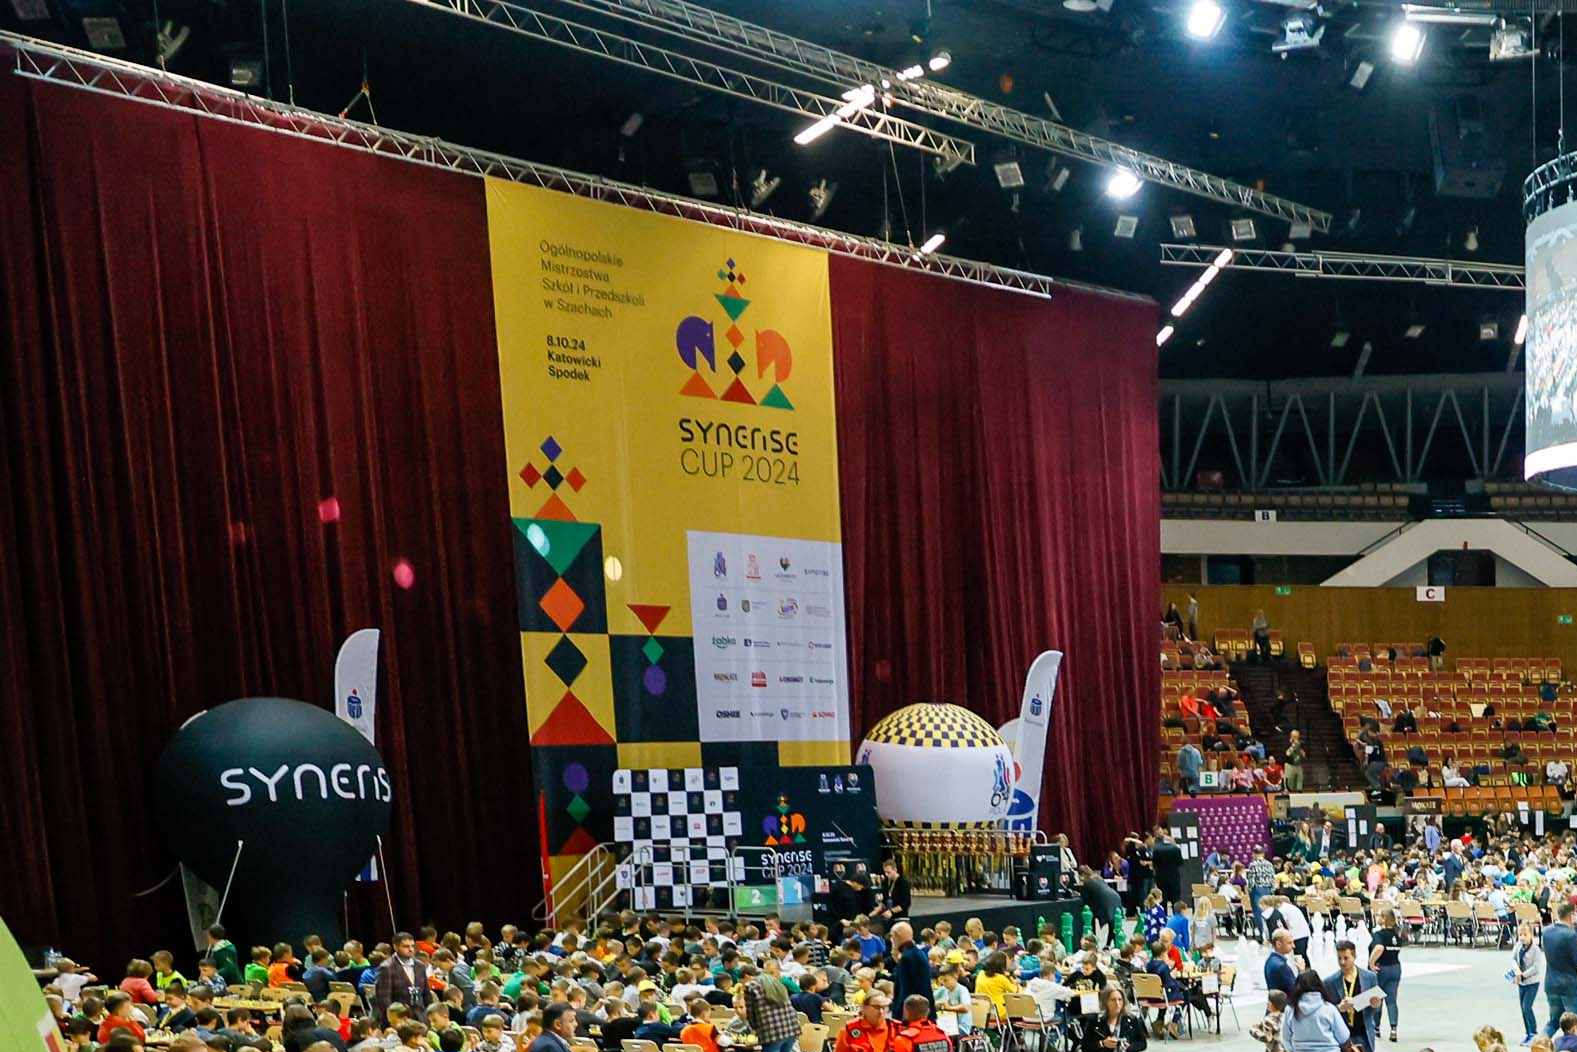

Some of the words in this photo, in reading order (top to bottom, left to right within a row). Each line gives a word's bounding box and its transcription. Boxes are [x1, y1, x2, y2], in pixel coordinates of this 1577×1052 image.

[539, 239, 624, 268] Ogólnopolskie
[541, 258, 610, 283] Mistrzostwa
[541, 277, 573, 295] Szkół
[543, 298, 553, 309] w
[557, 298, 613, 319] Szachach
[546, 334, 586, 352] 8.10.24
[547, 350, 602, 368] Katowicki
[548, 365, 590, 381] Spodek
[681, 448, 734, 478] CUP
[742, 455, 800, 486] 2024
[1261, 512, 1270, 520] B
[1426, 588, 1436, 599] C
[1205, 774, 1213, 784] B
[788, 863, 814, 877] 2024
[751, 889, 761, 904] 2
[793, 881, 803, 903] 1
